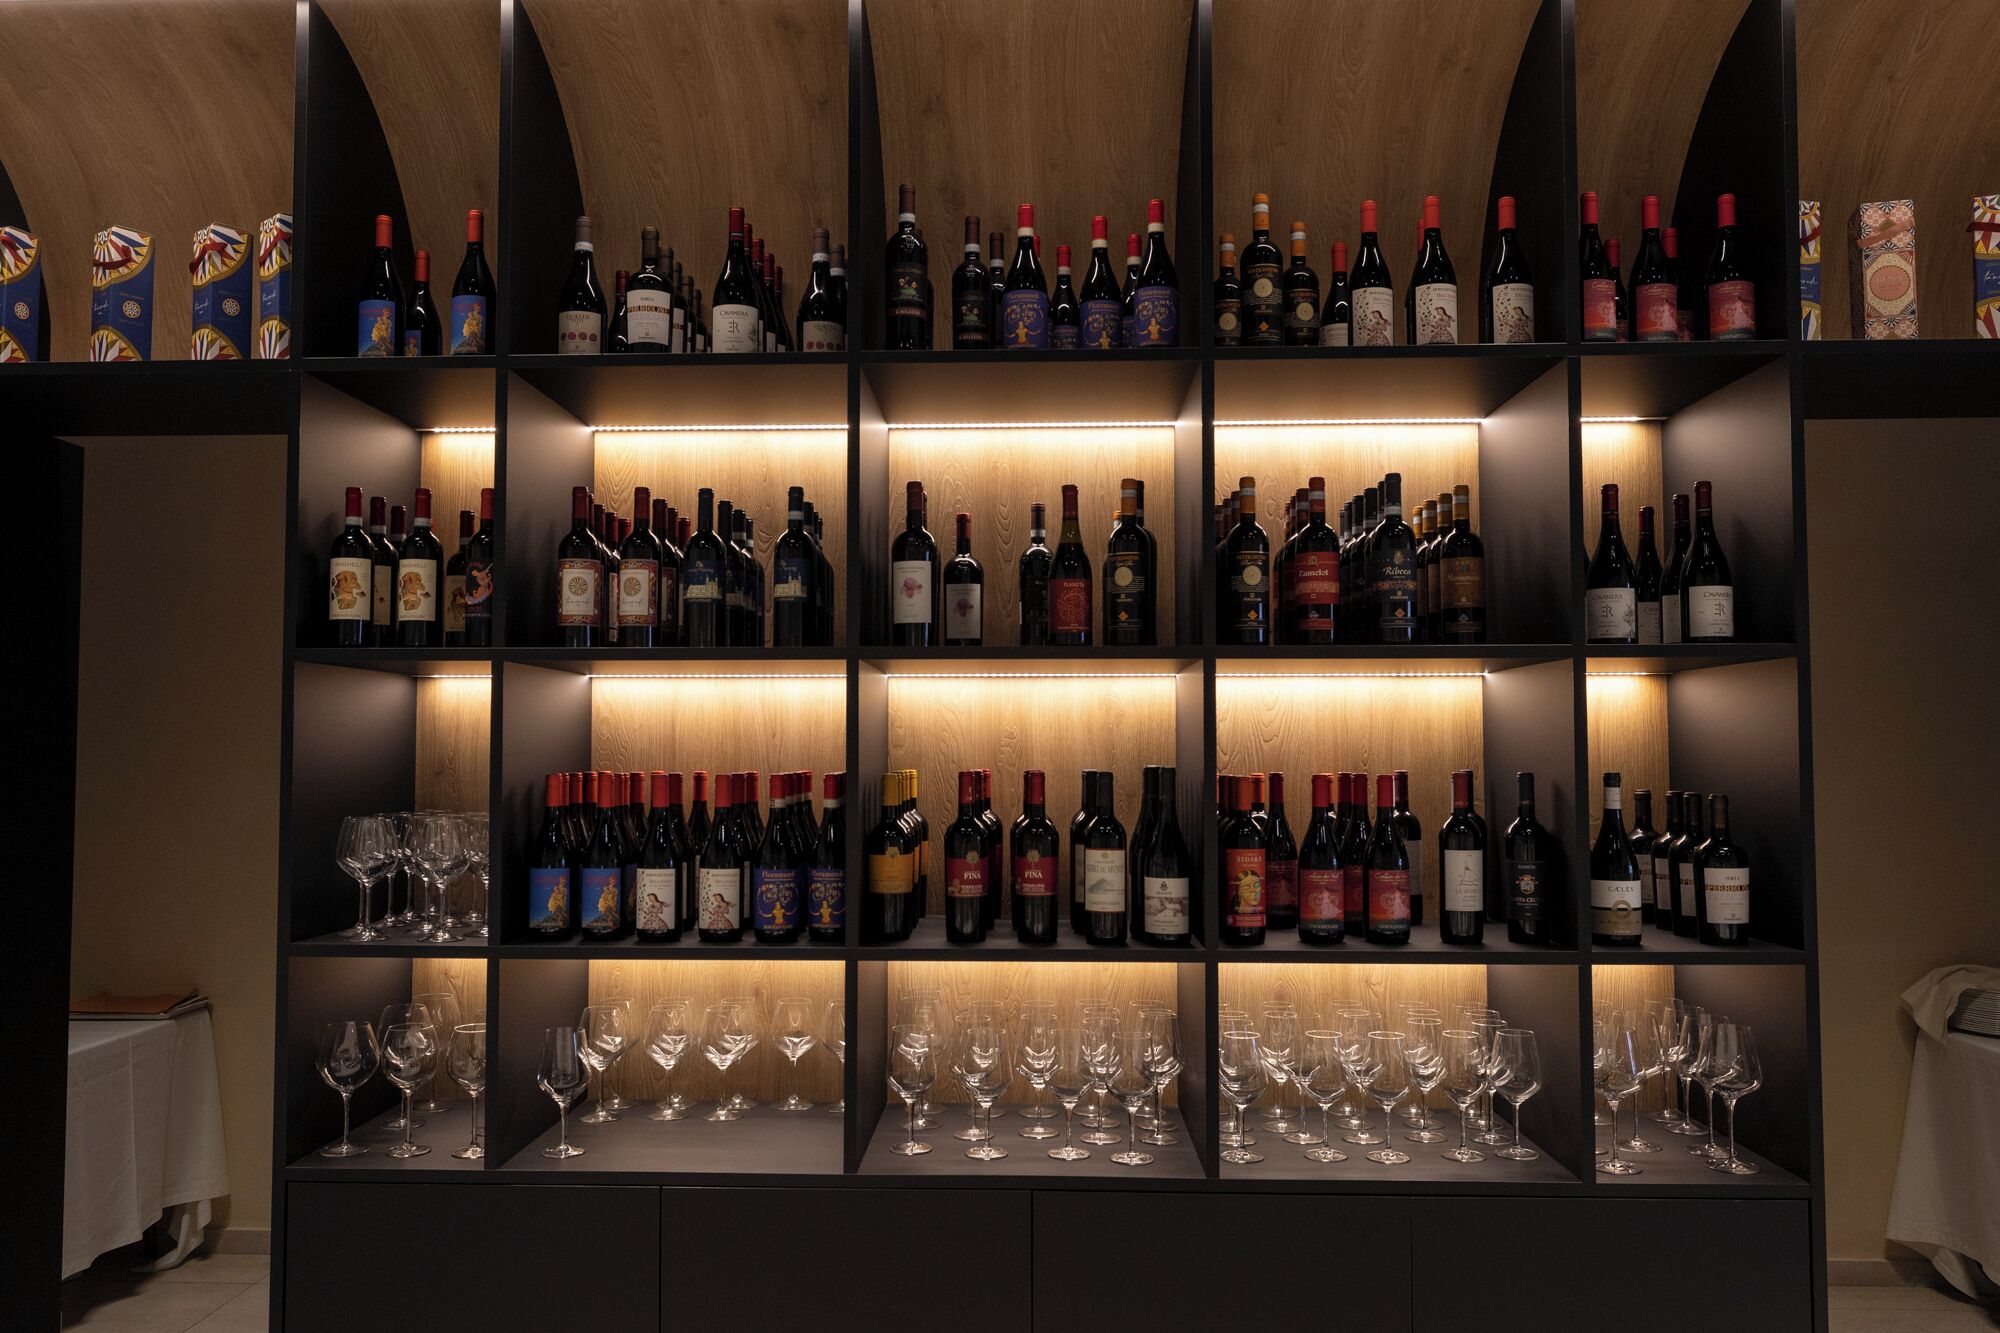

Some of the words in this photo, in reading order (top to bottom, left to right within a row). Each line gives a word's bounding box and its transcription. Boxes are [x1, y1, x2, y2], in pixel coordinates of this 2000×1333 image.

[1298, 569, 1329, 577] Camelot
[1383, 566, 1412, 576] Ribeca
[963, 871, 982, 880] FINA
[1024, 871, 1043, 879] FINA
